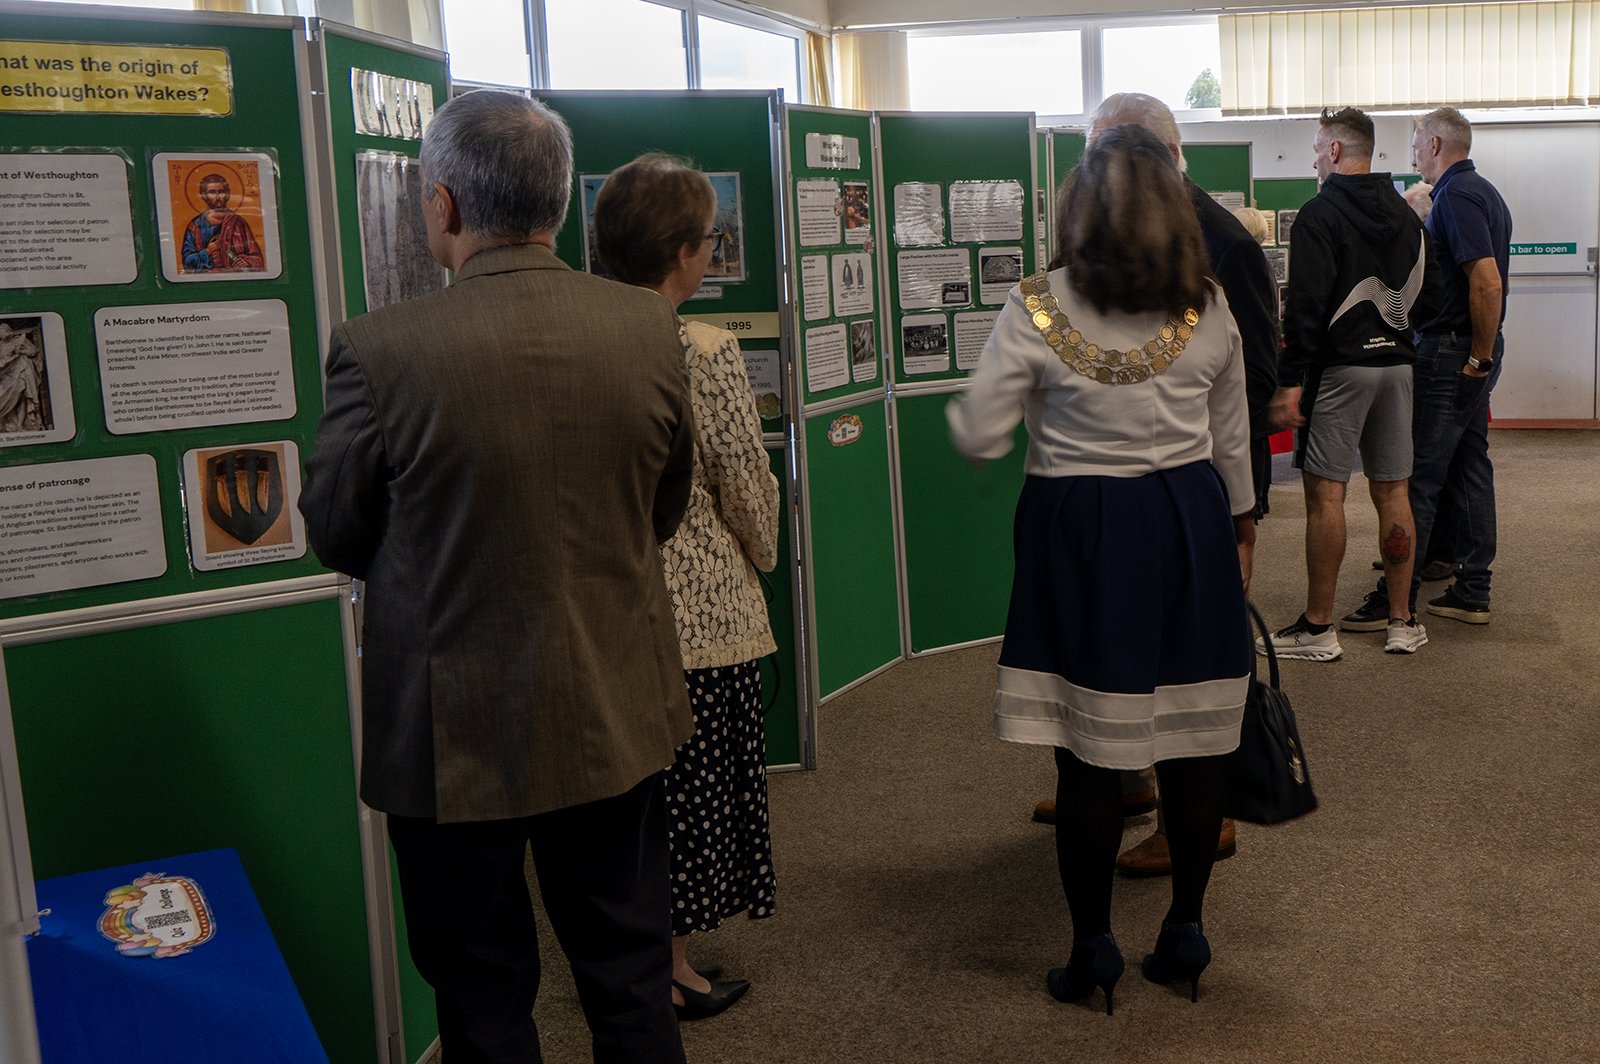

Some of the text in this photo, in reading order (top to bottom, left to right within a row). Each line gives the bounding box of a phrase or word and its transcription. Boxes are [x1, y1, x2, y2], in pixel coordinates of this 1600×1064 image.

[0, 56, 198, 77] hat was the origin of
[1, 84, 209, 102] esthoughton Wakes?
[24, 172, 99, 181] Westhoughton
[113, 318, 155, 326] Macabre
[158, 315, 210, 325] Martyrdom
[726, 322, 752, 330] 1995
[39, 478, 90, 490] patronage
